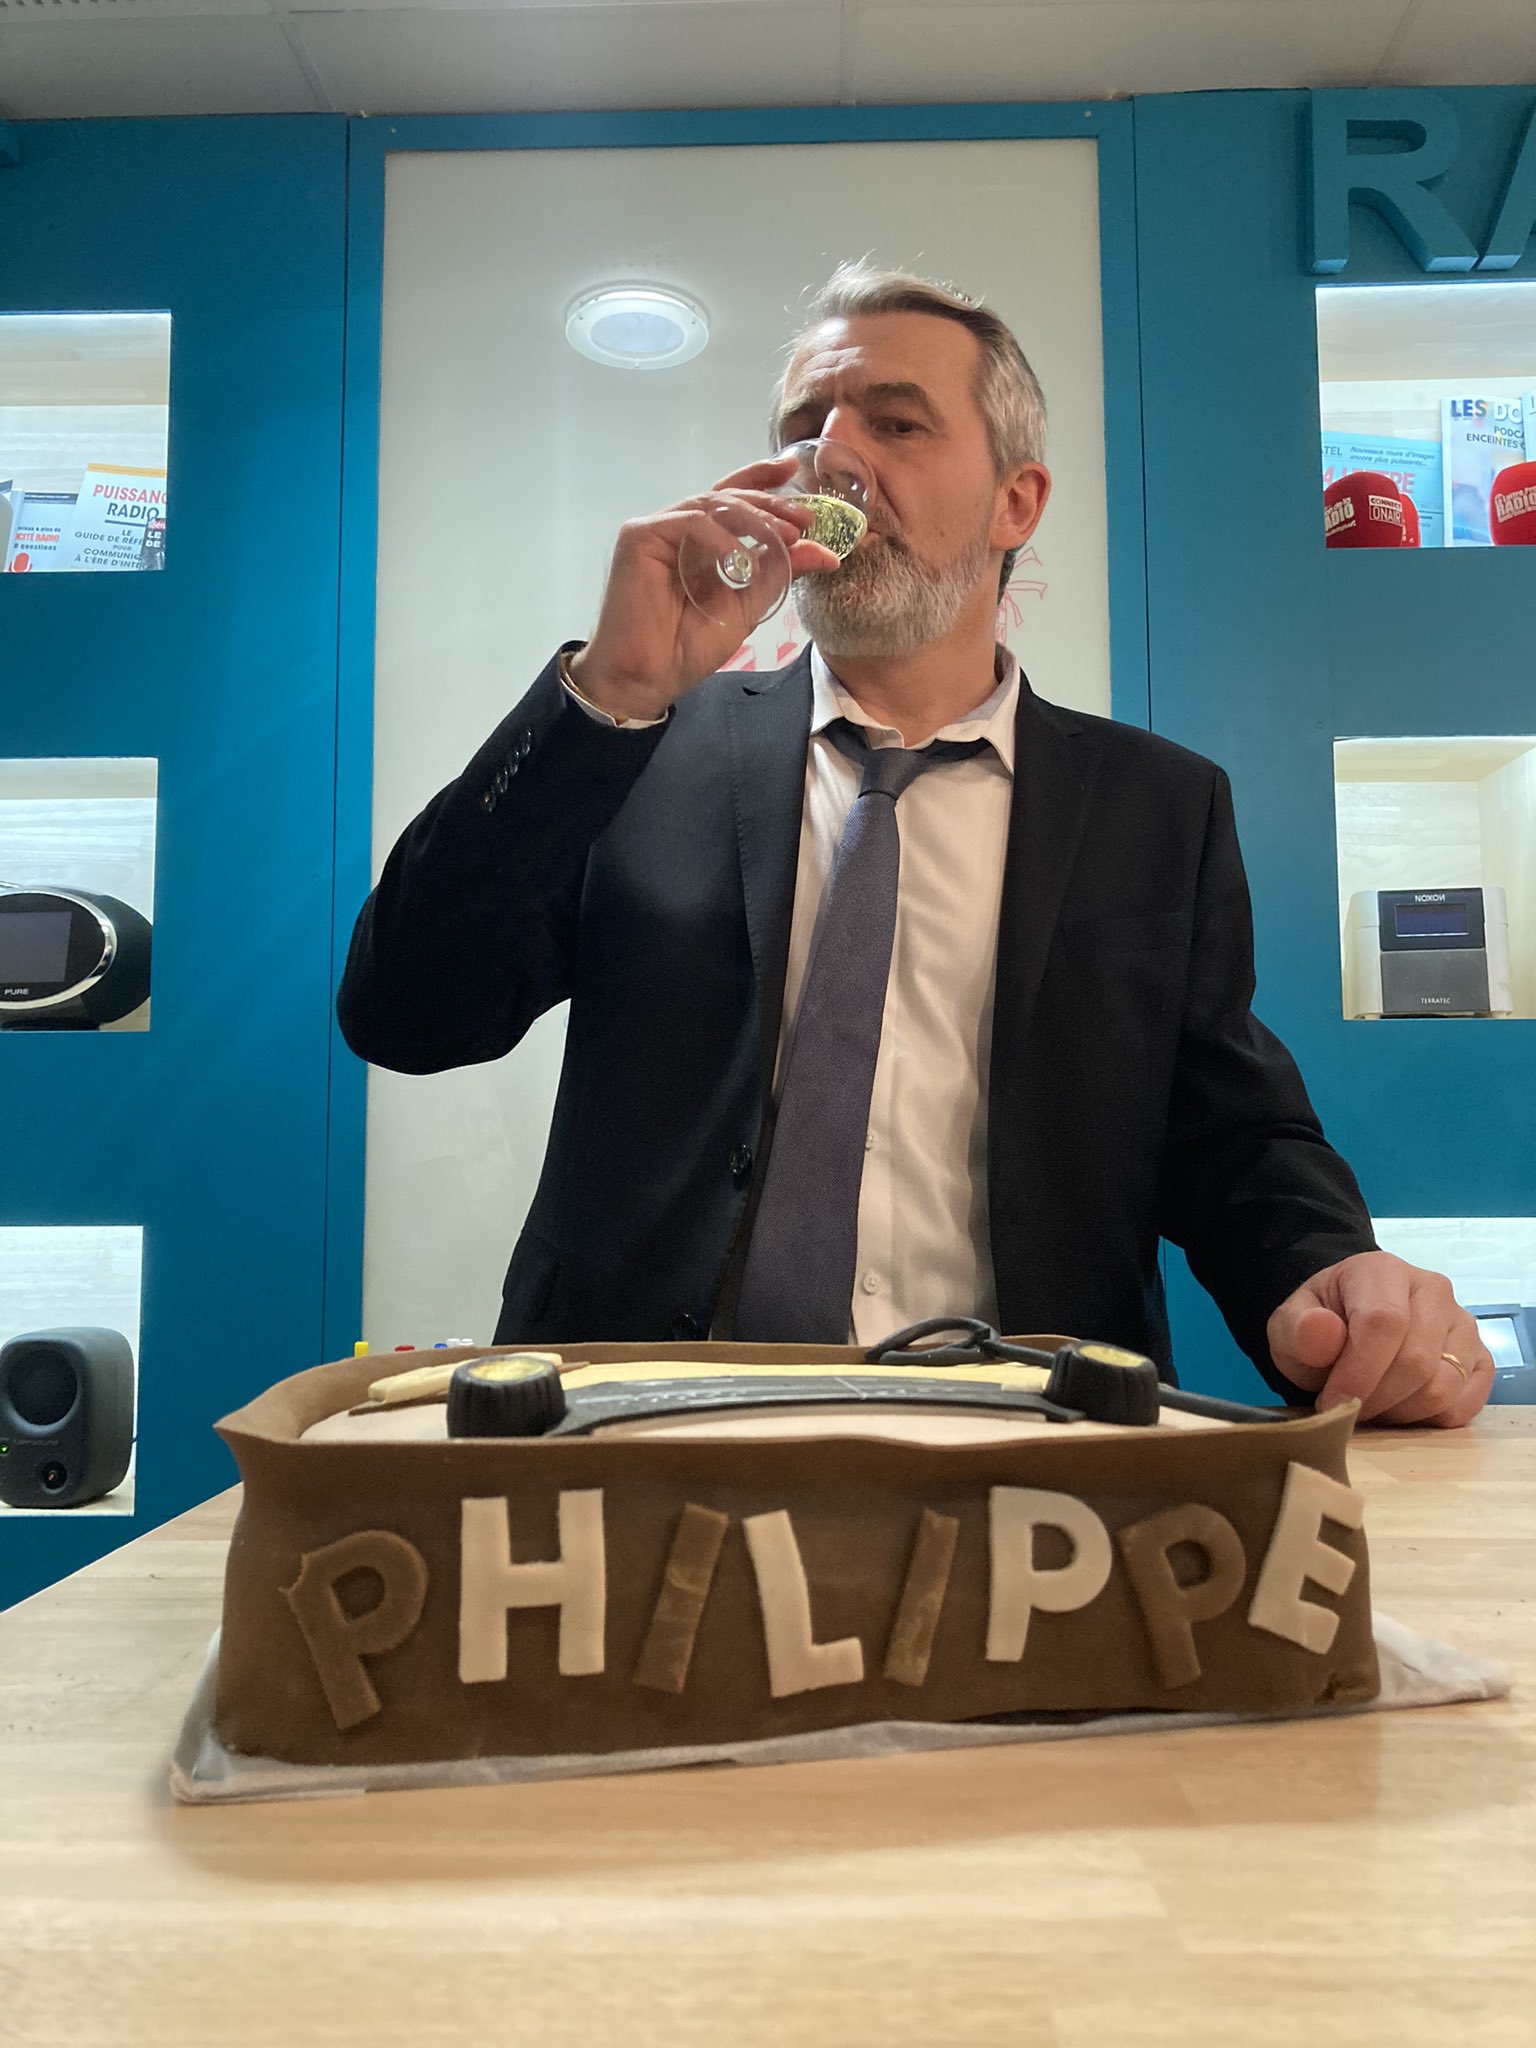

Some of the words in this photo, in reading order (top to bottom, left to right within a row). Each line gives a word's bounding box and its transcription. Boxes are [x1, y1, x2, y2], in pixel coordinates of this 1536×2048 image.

[1451, 399, 1487, 418] LES
[1466, 433, 1518, 449] ENCEINTES
[107, 502, 160, 520] RADIO
[75, 531, 105, 541] GUIDE
[107, 535, 120, 543] DE
[122, 529, 132, 537] LE
[21, 543, 57, 551] questions
[1421, 997, 1451, 1005] TERRATEC
[279, 1461, 1366, 1731] PHILIPPE
